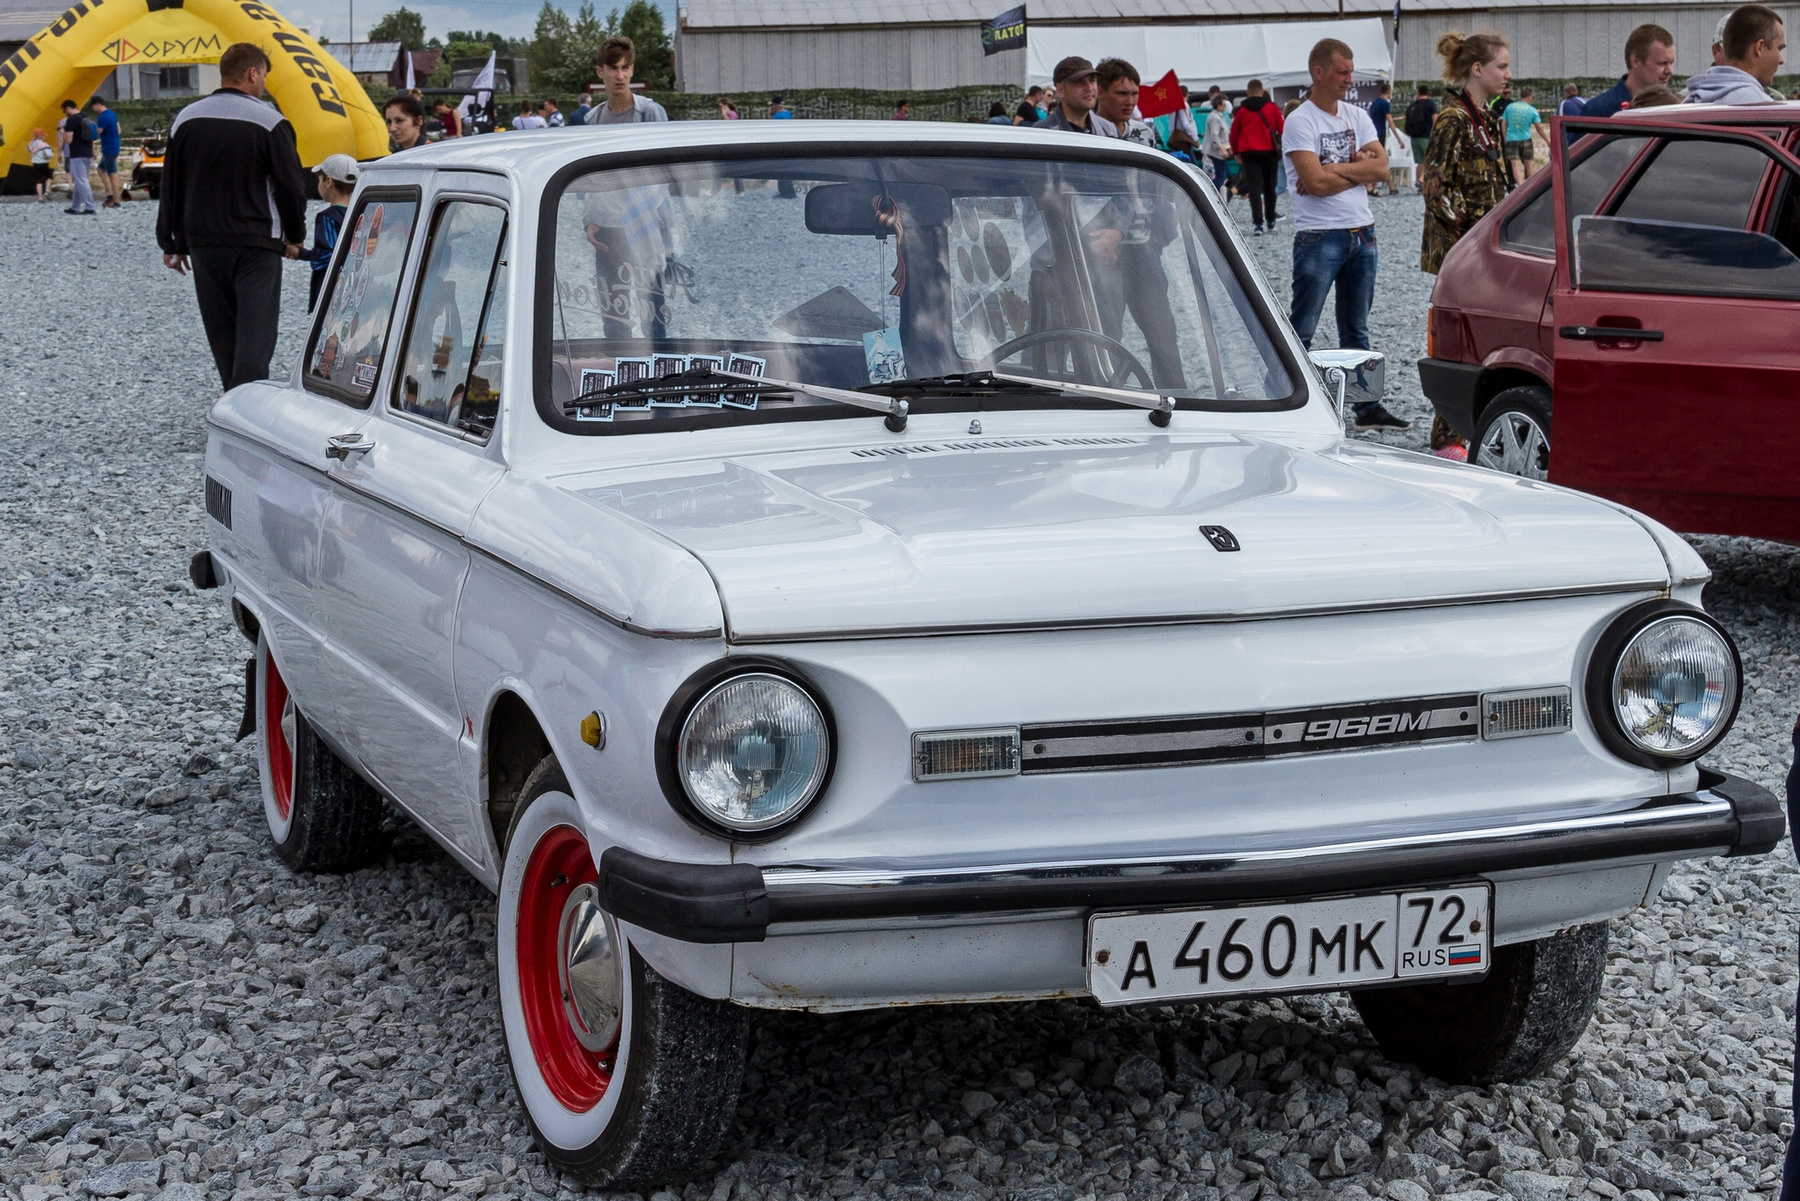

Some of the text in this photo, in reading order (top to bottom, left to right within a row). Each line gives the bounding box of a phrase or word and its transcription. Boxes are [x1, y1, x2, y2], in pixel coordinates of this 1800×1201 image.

[1304, 711, 1431, 741] 968М
[1408, 895, 1465, 948] 72
[1402, 949, 1446, 969] RUS
